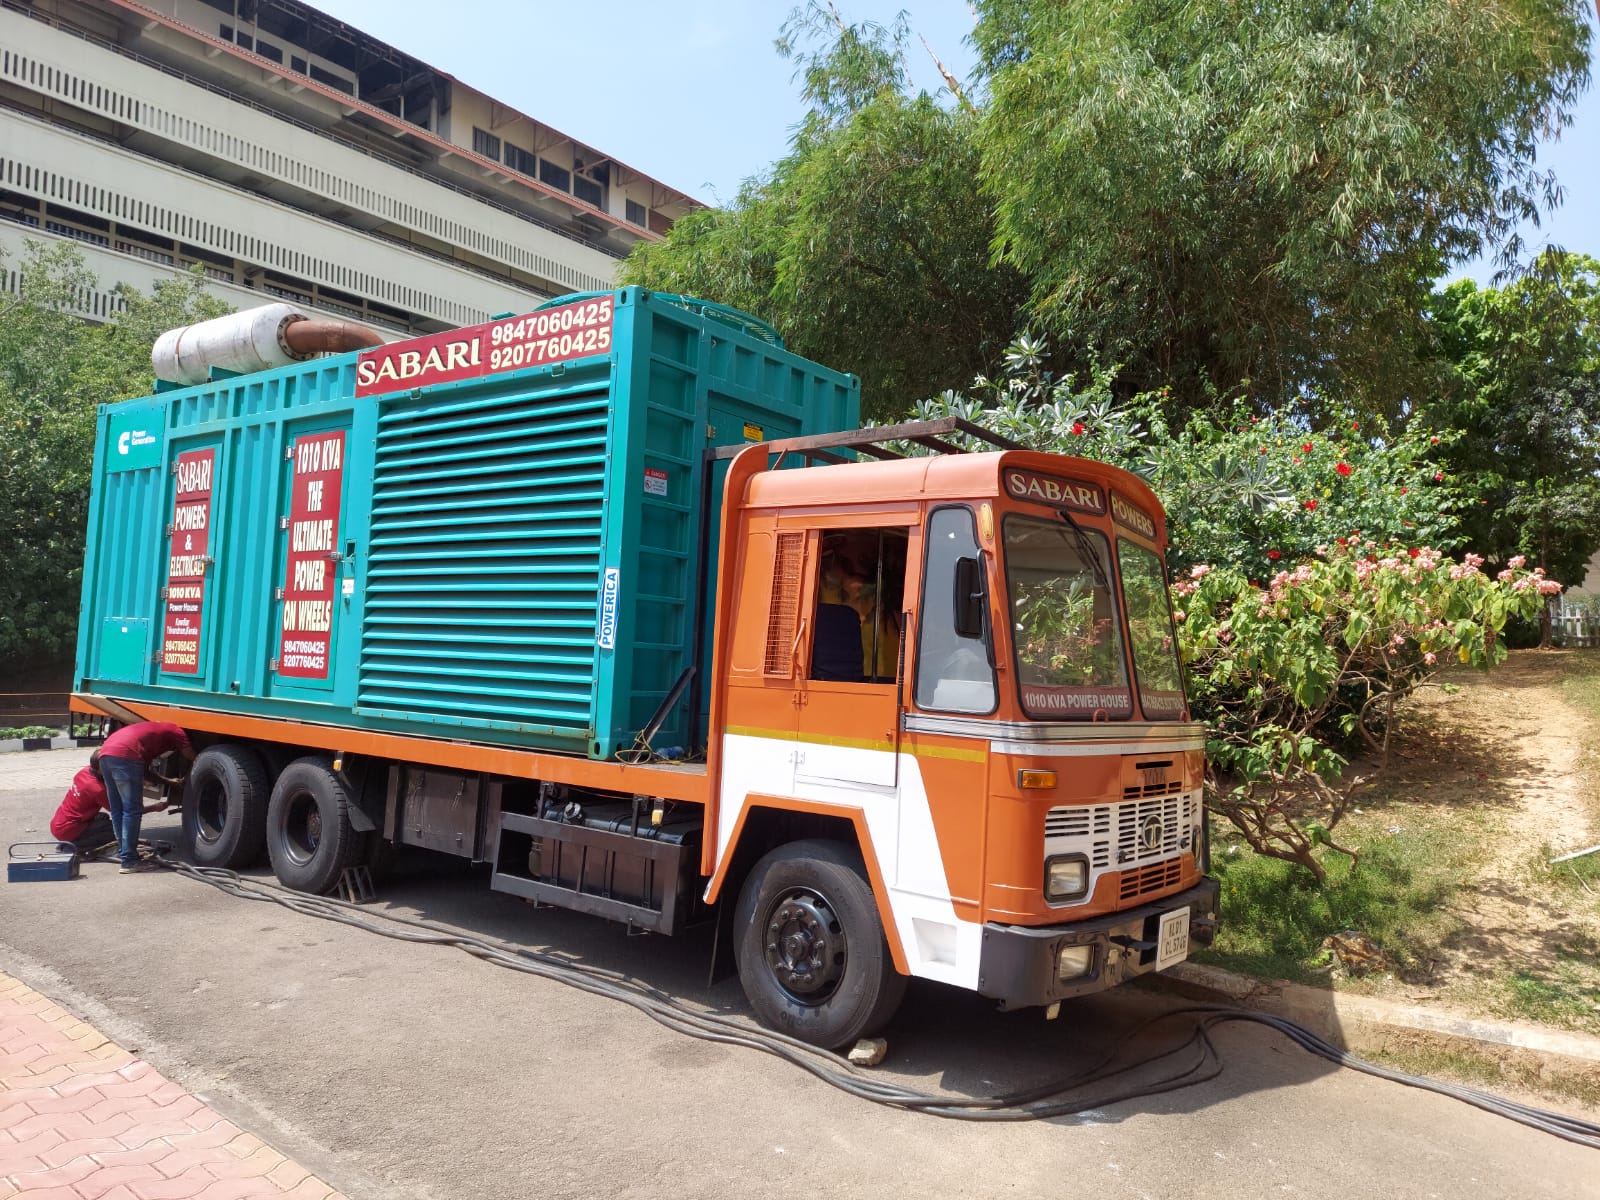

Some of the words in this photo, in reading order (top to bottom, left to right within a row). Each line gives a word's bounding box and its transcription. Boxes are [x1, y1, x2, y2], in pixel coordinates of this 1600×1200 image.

[491, 300, 611, 346] 9847060425
[357, 337, 482, 387] SABARI
[490, 326, 611, 370] 9207760425
[297, 441, 321, 474] 1010
[321, 438, 341, 471] KVA
[177, 459, 212, 494] SABARI
[1010, 473, 1102, 509] SABARI
[307, 480, 324, 512] THE
[175, 504, 207, 531] POWERS
[1111, 495, 1154, 537] POWERS
[184, 534, 192, 550] &
[292, 519, 333, 553] ULTIMATE
[293, 560, 326, 592] POWER
[169, 587, 184, 599] 1010
[184, 587, 201, 599] KVA
[602, 572, 617, 646] POWERICA
[283, 600, 297, 631] ON
[298, 600, 331, 632] WHEELS
[283, 655, 324, 669] 9207760425
[284, 640, 325, 655] 9847060425
[1025, 693, 1046, 708] 1010
[1047, 694, 1067, 708] KVA
[1067, 694, 1099, 708] POWER
[1100, 694, 1129, 708] HOUSE
